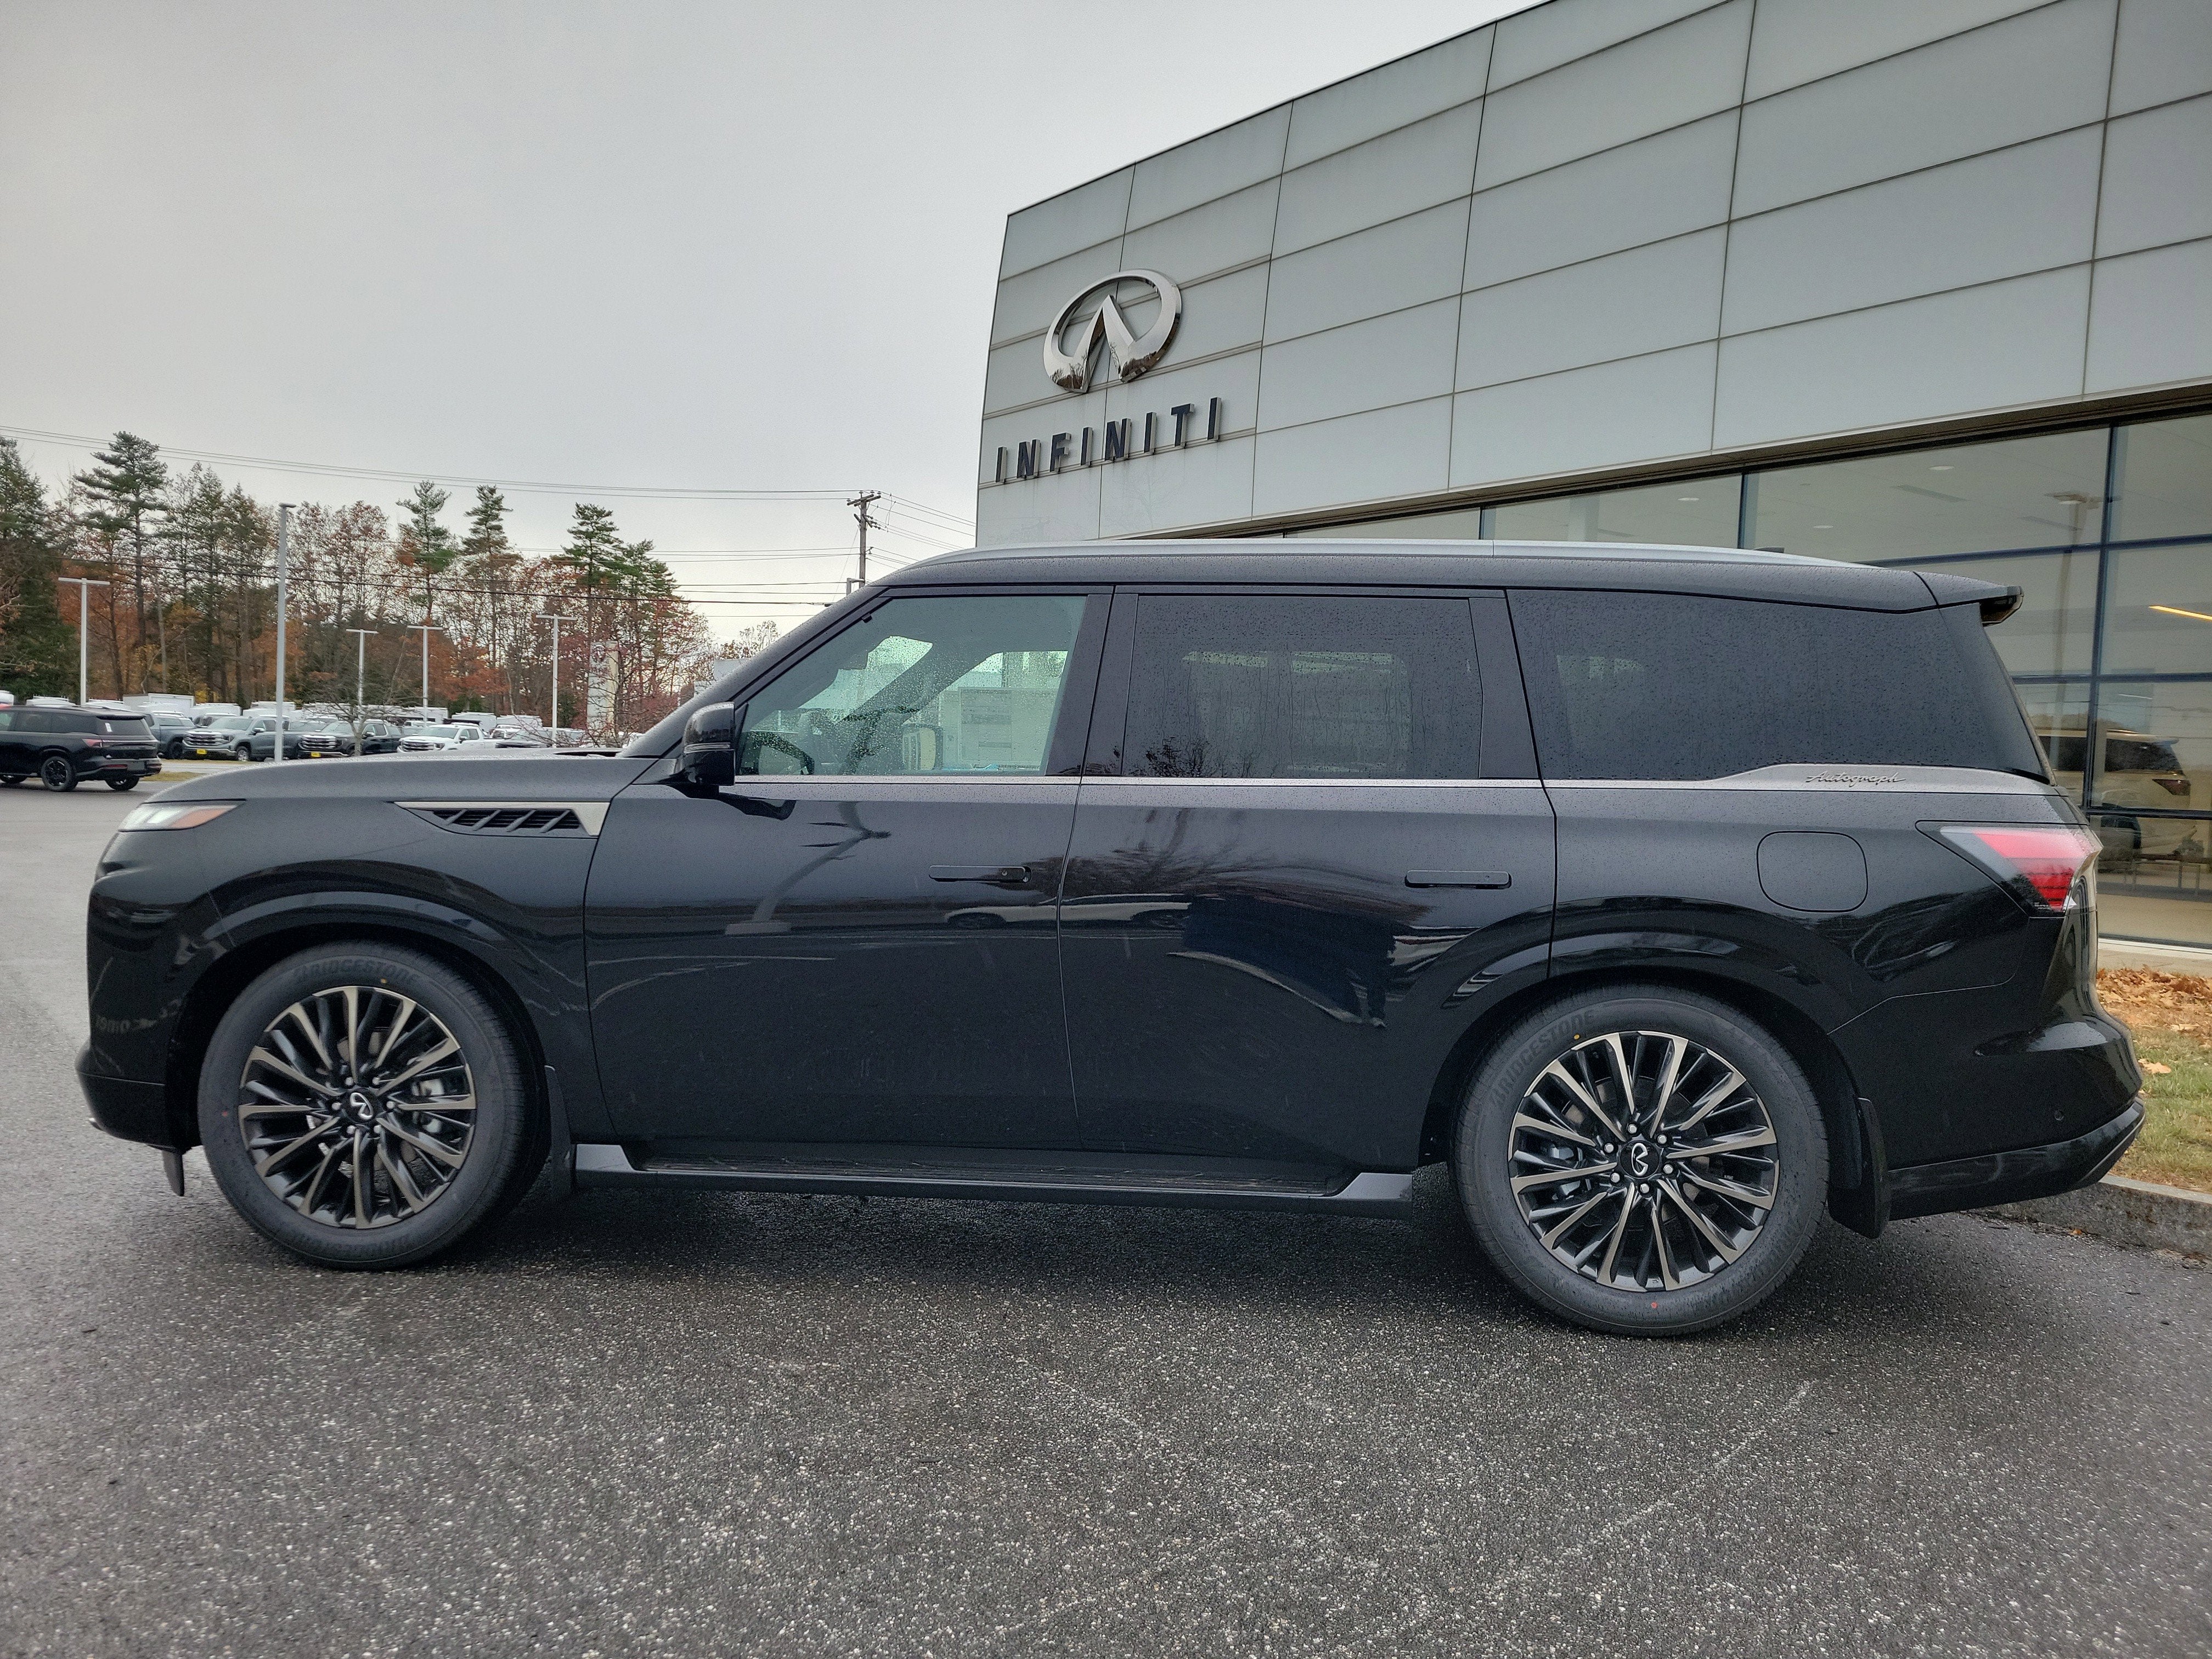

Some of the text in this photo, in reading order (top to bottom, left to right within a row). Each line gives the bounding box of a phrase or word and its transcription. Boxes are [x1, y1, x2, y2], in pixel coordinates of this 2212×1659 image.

[995, 397, 1222, 484] INFINITI
[1805, 771, 1906, 787] Autograph
[1488, 1008, 1594, 1106] BRIDGESTONE
